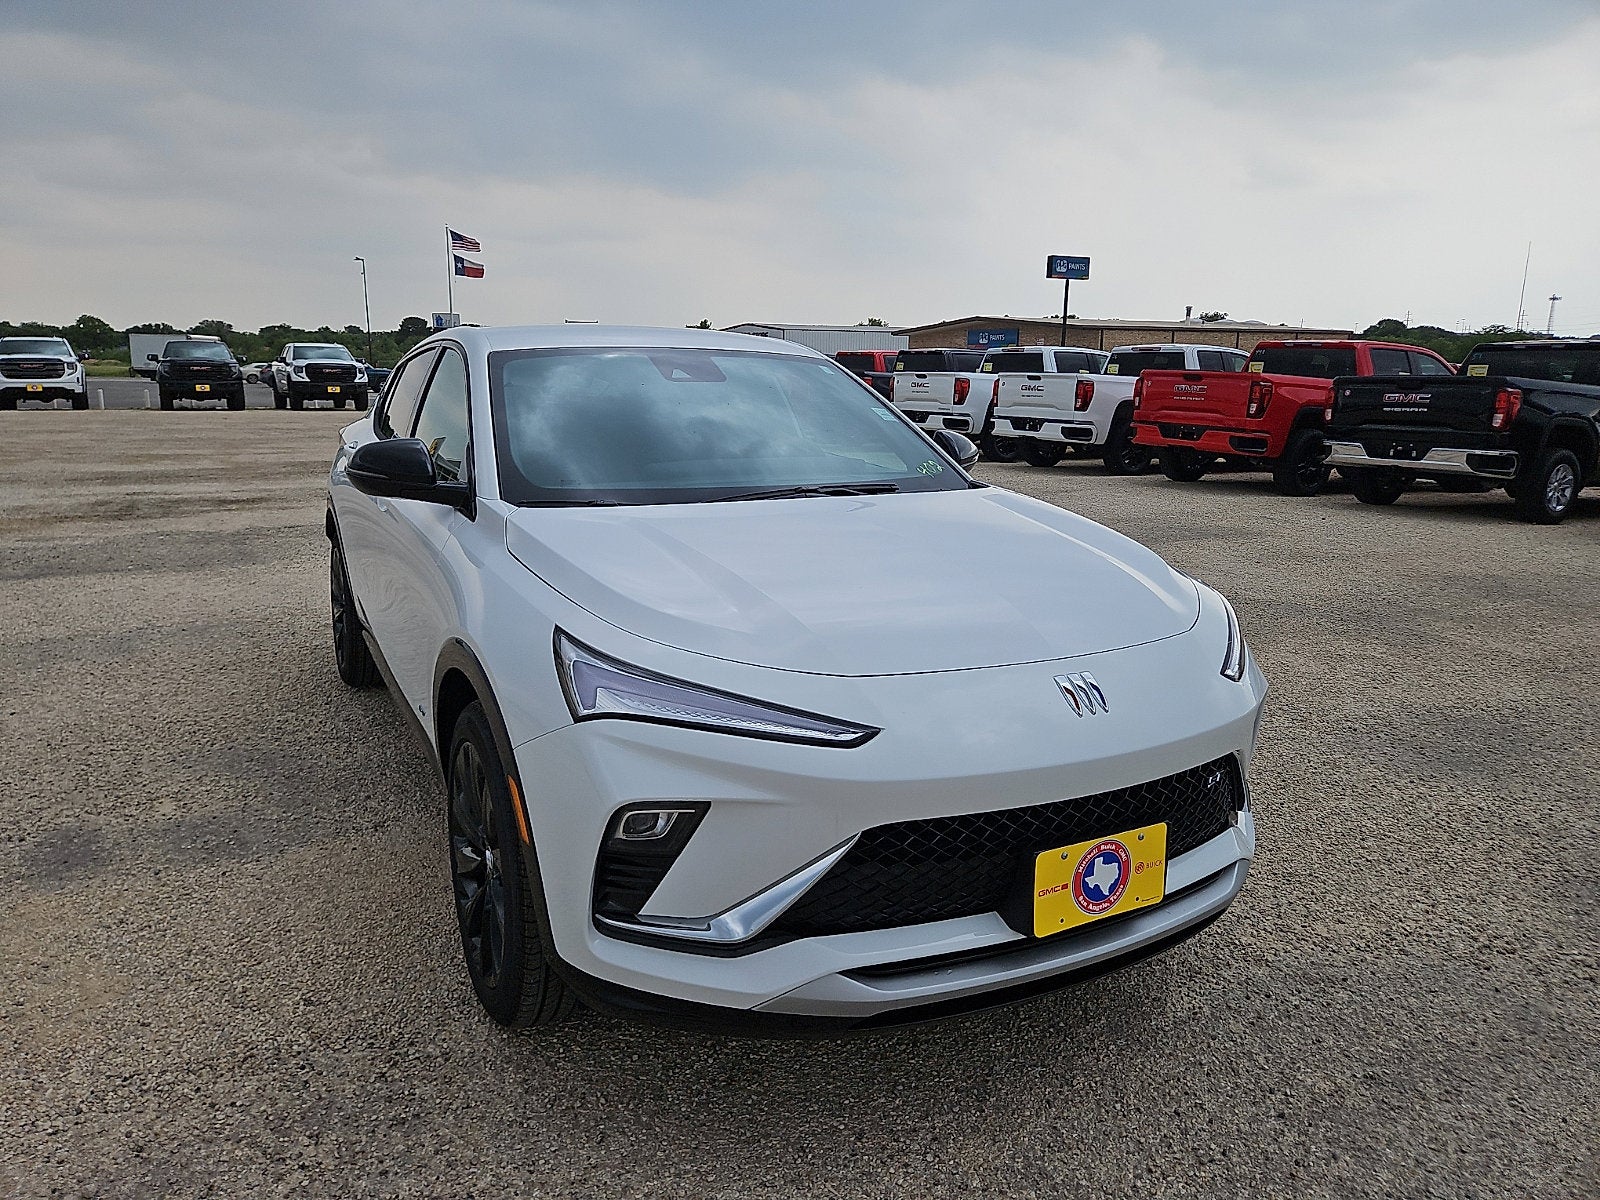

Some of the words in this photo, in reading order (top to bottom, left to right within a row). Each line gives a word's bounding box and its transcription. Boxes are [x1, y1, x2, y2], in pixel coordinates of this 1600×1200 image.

[1068, 262, 1086, 271] PAINTS
[1173, 384, 1207, 393] GMC
[1383, 393, 1432, 403] GMC
[1118, 848, 1128, 862] GMC
[1146, 859, 1163, 869] BUICK
[1038, 884, 1061, 897] GMC
